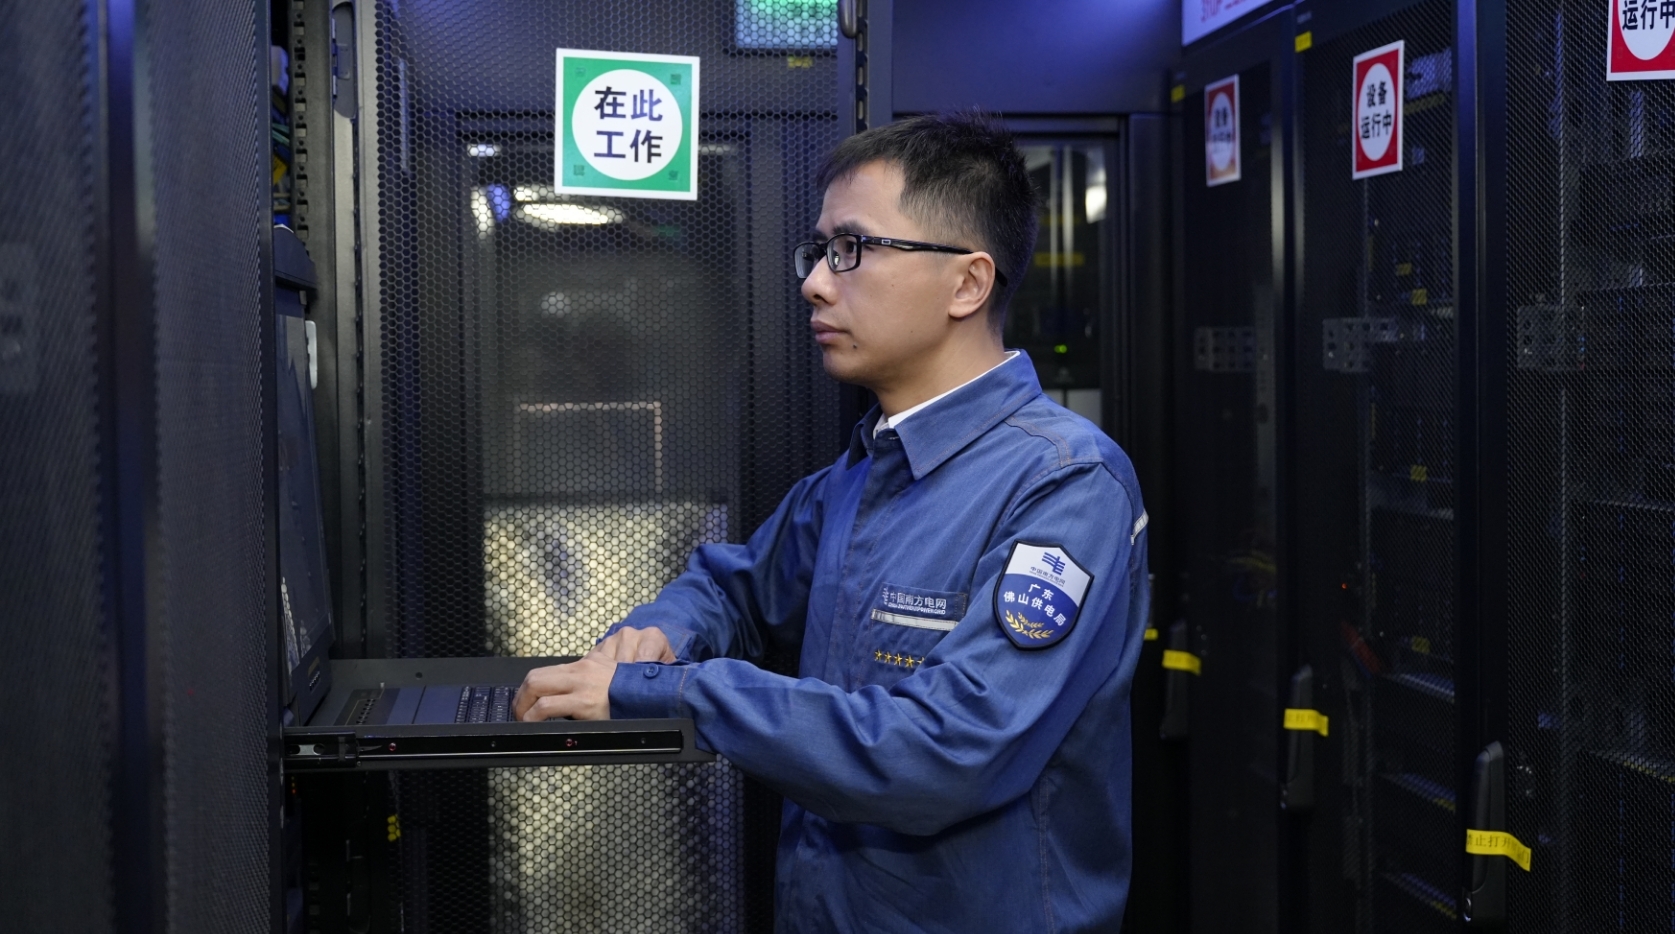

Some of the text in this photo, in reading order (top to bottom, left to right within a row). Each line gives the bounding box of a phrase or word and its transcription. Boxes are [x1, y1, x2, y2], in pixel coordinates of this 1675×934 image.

[1622, 0, 1675, 31] 运行中
[594, 86, 663, 121] 在此
[1367, 80, 1387, 108] 设备
[1361, 109, 1392, 139] 运行中
[594, 129, 663, 163] 工作
[890, 592, 947, 609] 中国南方电网
[1028, 583, 1054, 601] 广东
[1004, 590, 1066, 626] 佛山供电局
